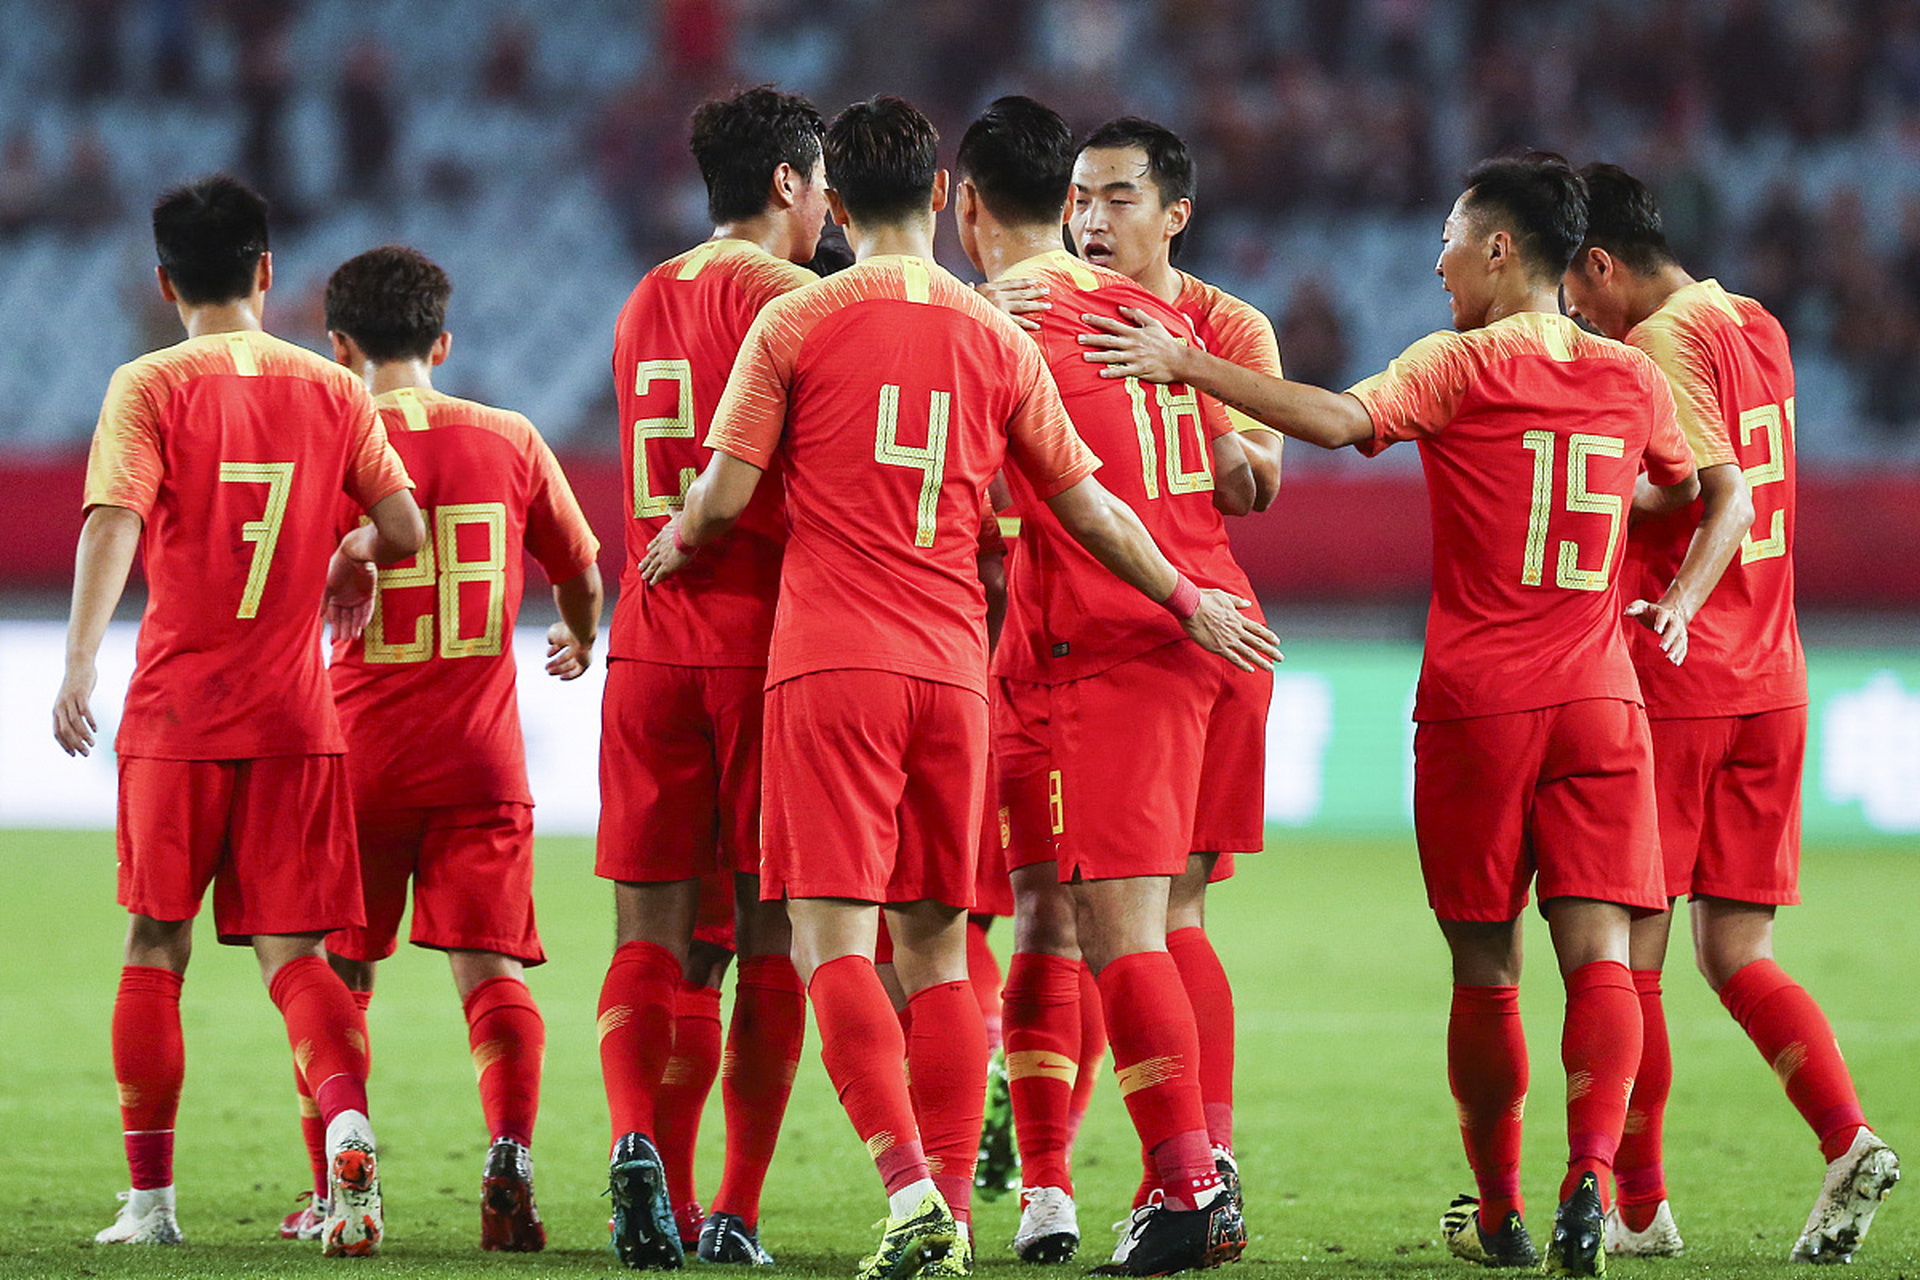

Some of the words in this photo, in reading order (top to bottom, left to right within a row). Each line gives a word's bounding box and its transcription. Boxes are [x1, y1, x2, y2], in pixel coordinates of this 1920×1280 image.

[633, 359, 697, 519] 2
[875, 384, 951, 548] 4
[1107, 337, 1215, 500] 18
[219, 462, 295, 619] 7
[359, 502, 506, 663] 28
[1521, 430, 1625, 591] 15
